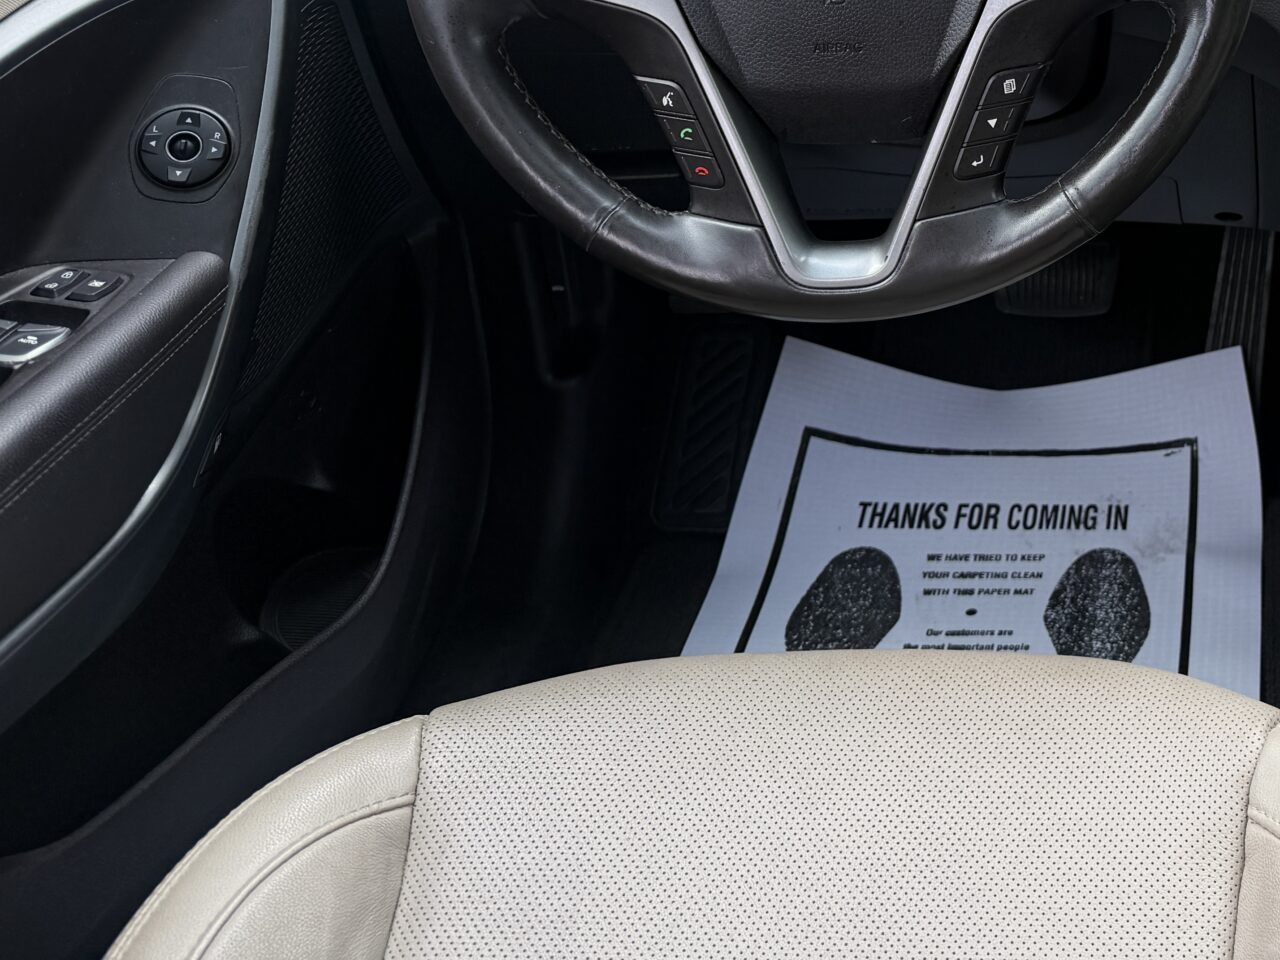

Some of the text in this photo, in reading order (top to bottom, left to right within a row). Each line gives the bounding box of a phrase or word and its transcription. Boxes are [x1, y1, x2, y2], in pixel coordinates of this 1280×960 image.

[858, 502, 1129, 531] THANKS FOR COMING IN
[996, 643, 1030, 651] people
